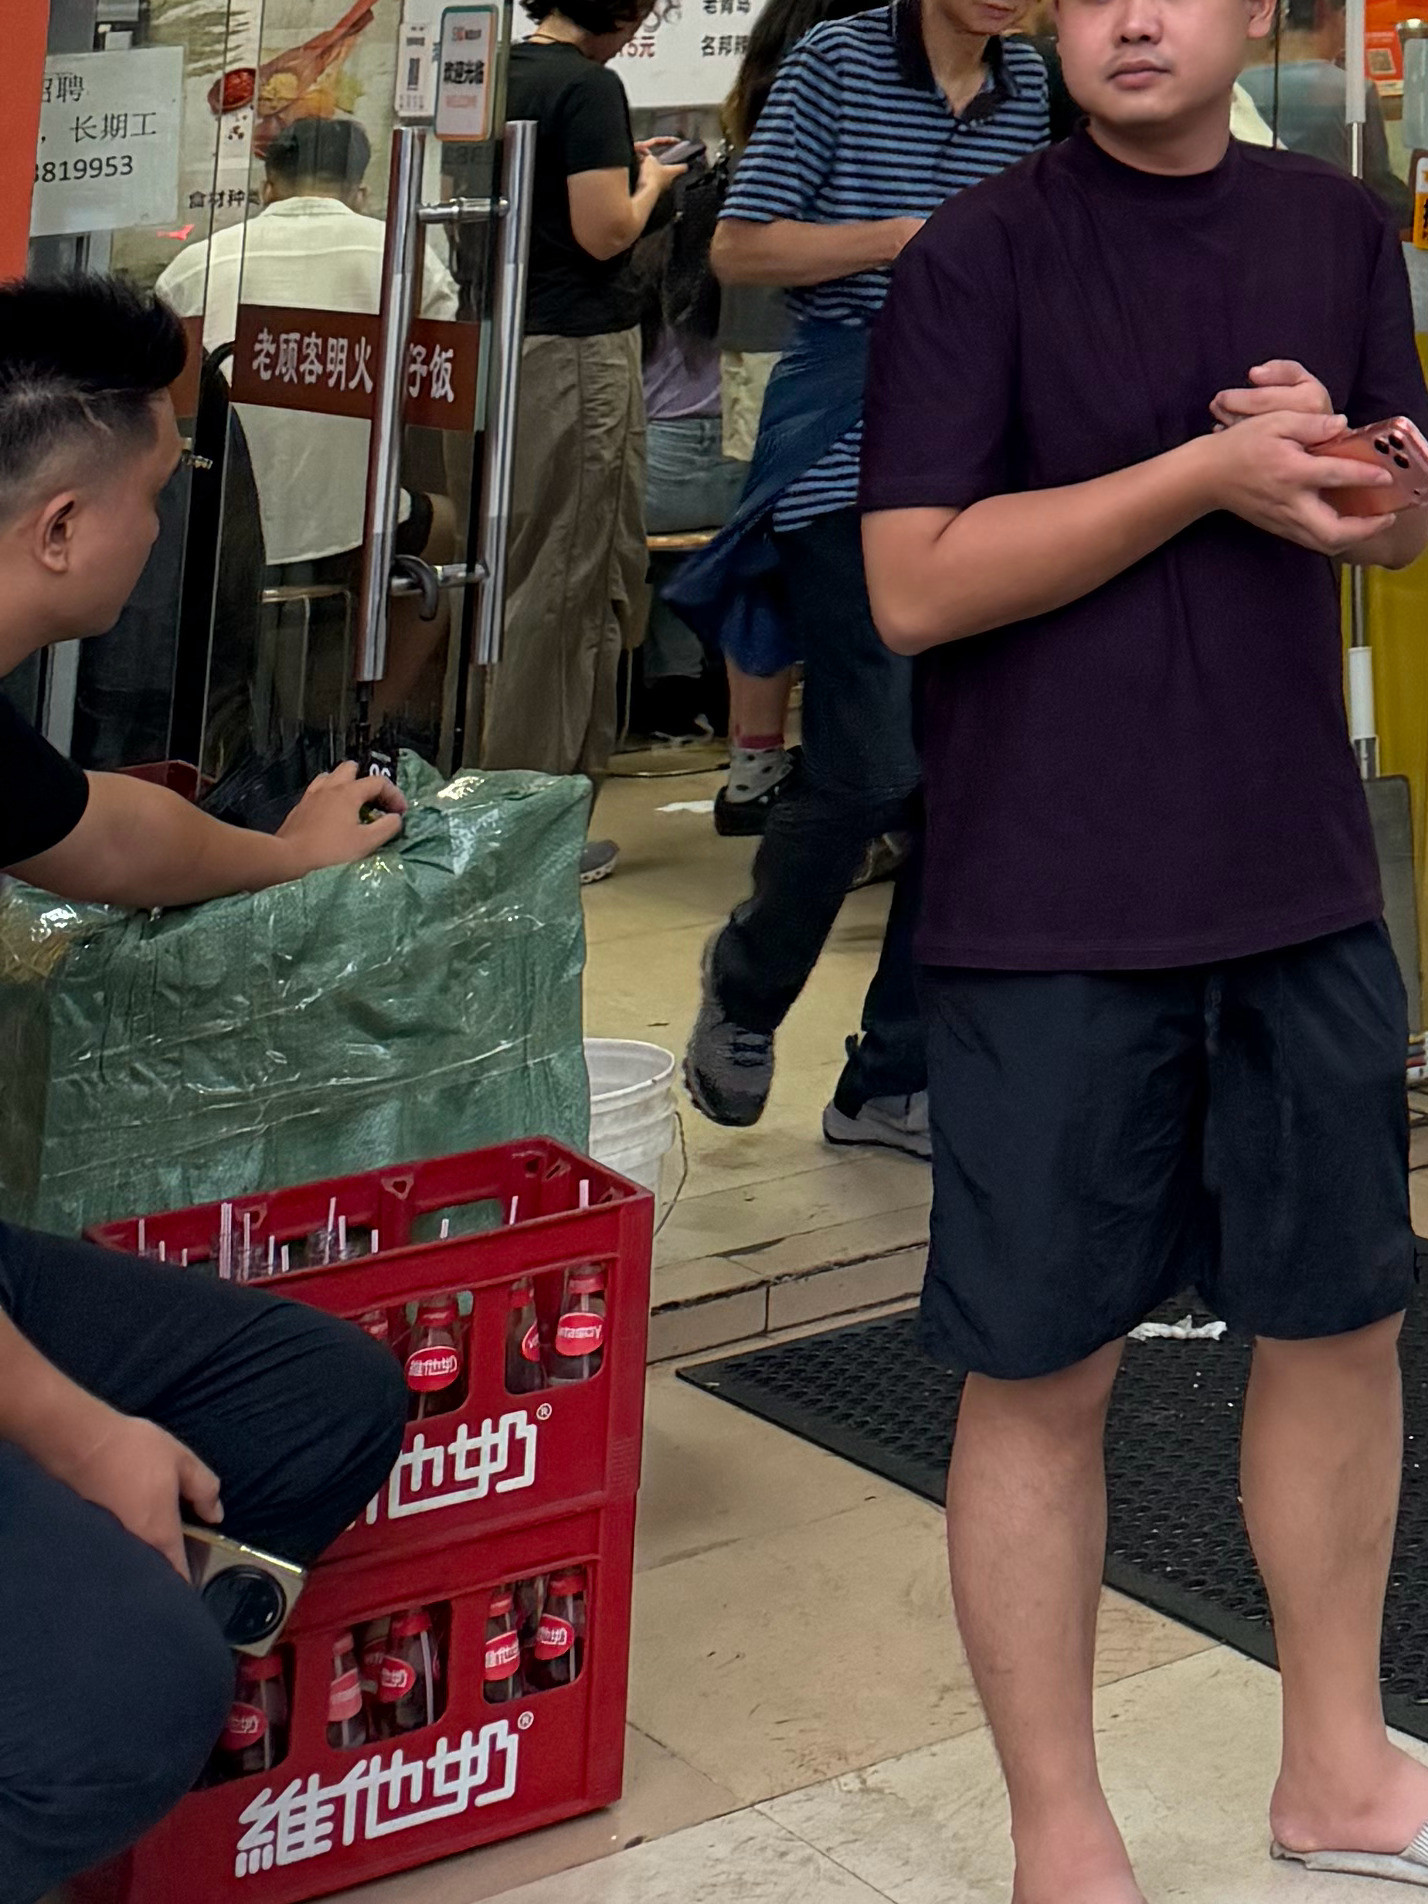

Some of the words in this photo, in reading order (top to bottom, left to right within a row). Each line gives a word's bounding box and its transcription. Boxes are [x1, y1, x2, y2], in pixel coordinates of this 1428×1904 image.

[252, 325, 456, 404] 老顾客明火仔饭
[347, 1408, 538, 1529] 他奶
[235, 1718, 520, 1878] 維他奶
